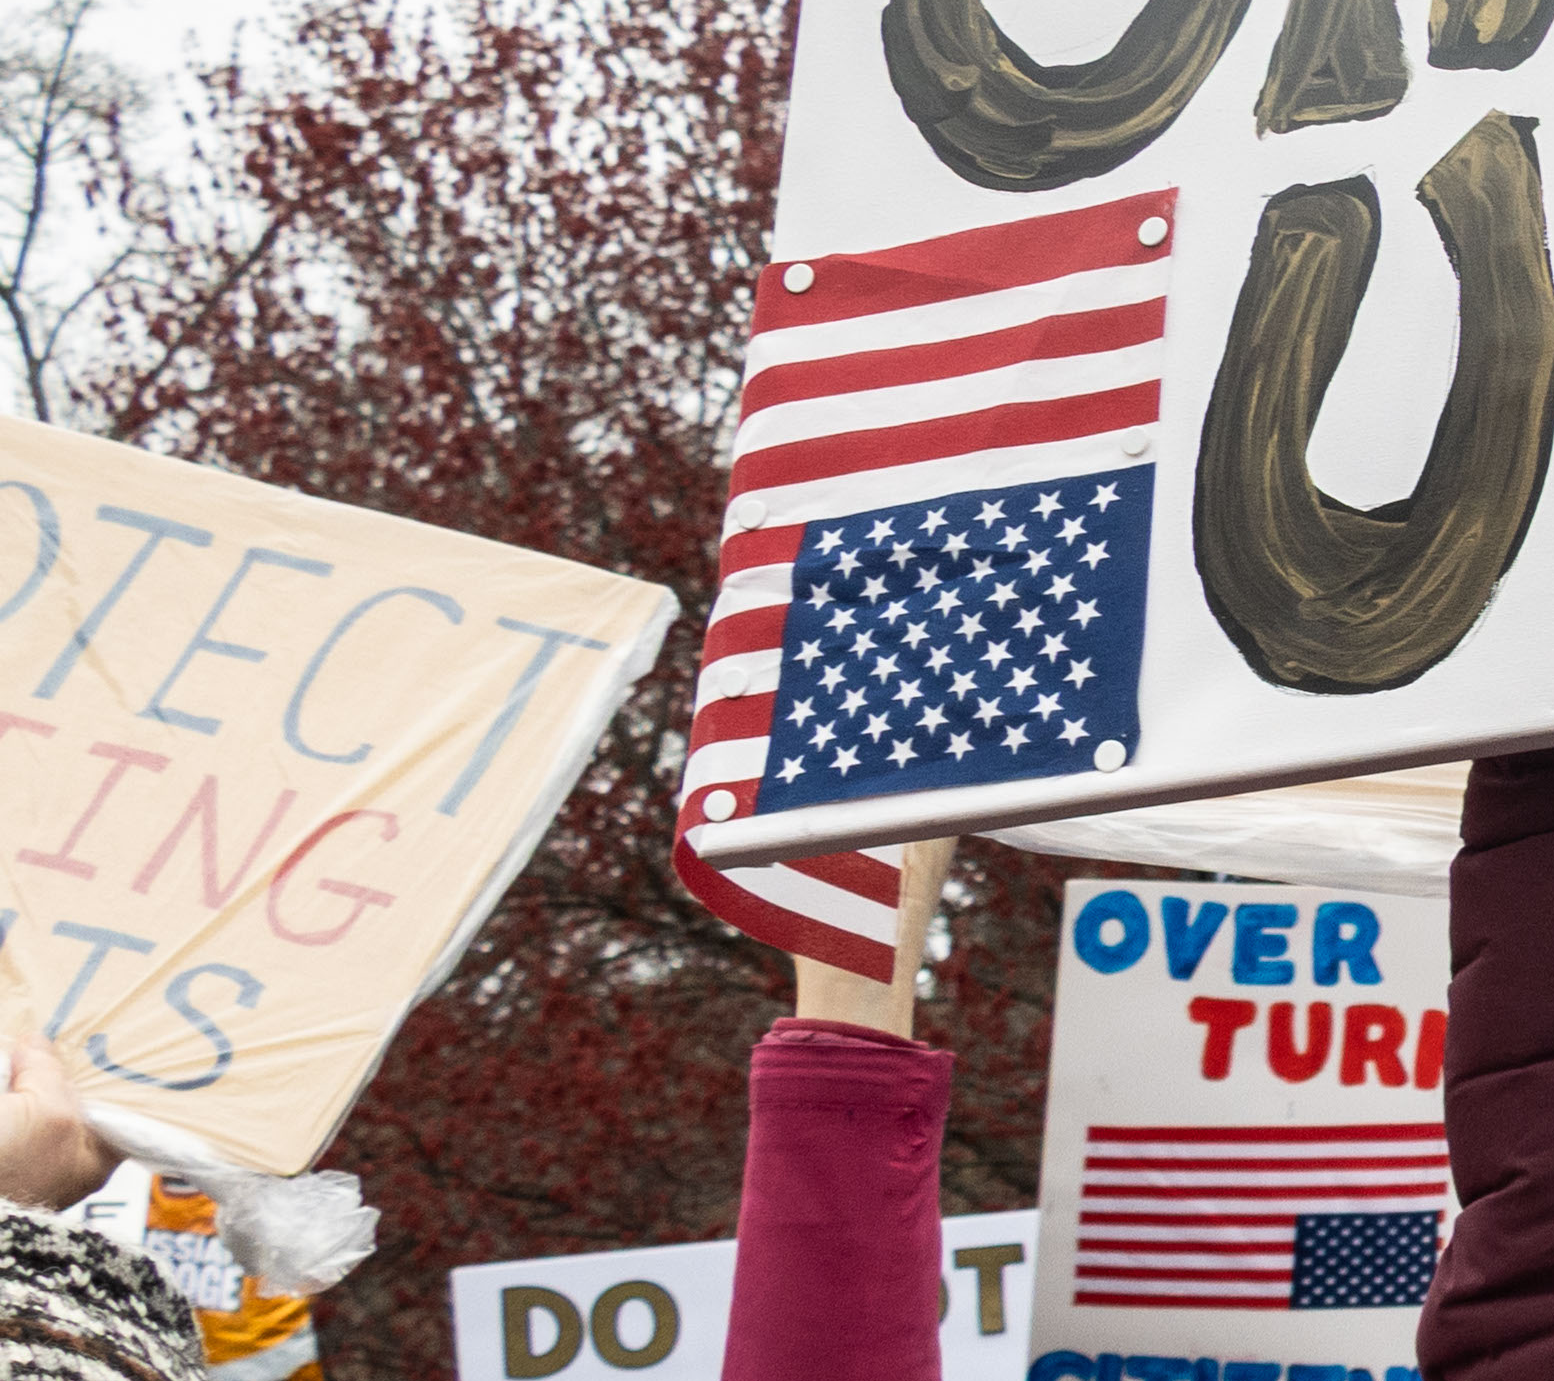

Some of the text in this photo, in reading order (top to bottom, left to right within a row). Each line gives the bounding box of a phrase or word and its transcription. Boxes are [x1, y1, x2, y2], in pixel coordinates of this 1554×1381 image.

[1072, 889, 1383, 987] OVER
[0, 907, 266, 1091] TS
[500, 1279, 681, 1381] DO
